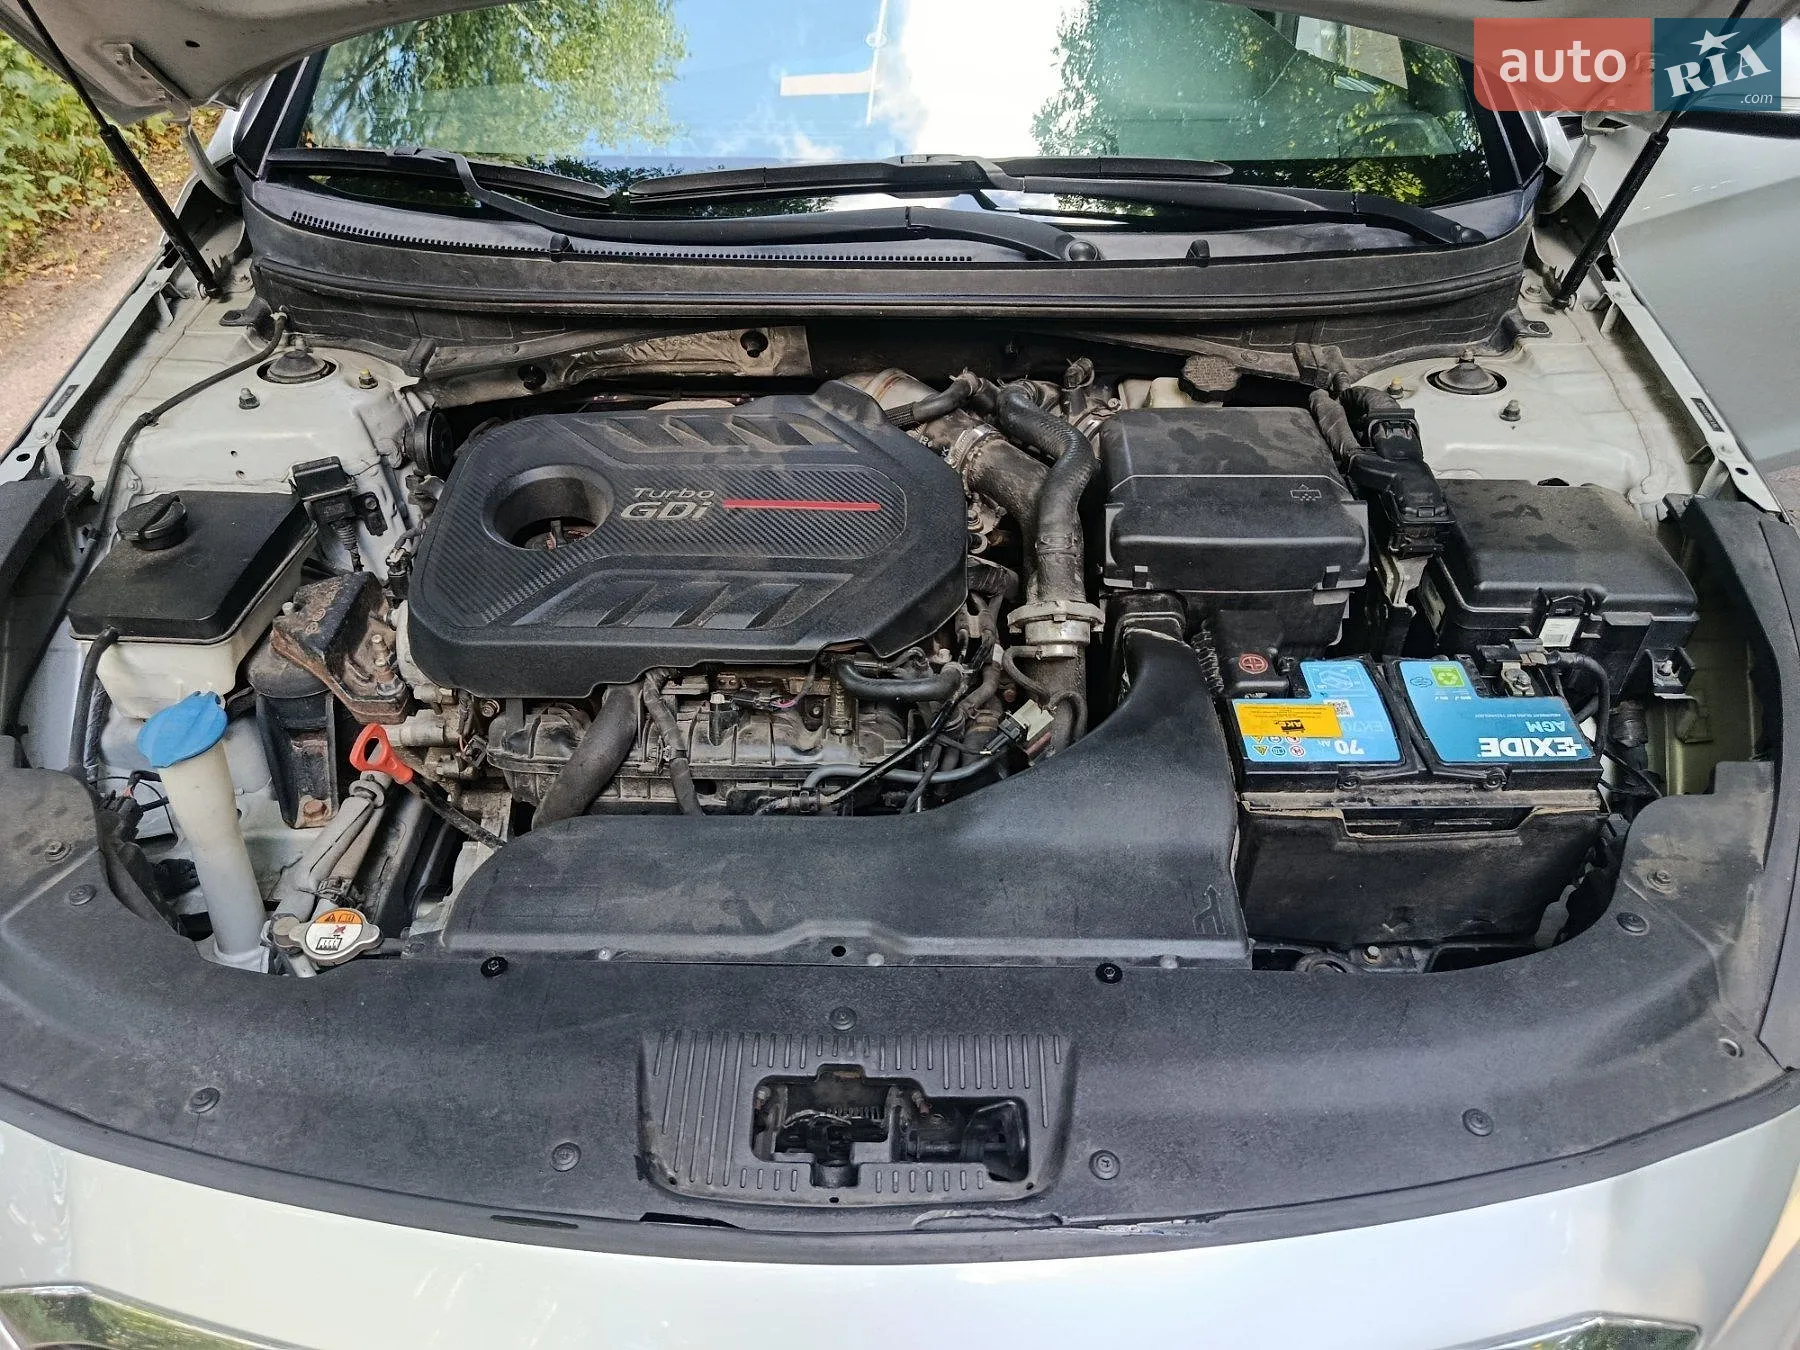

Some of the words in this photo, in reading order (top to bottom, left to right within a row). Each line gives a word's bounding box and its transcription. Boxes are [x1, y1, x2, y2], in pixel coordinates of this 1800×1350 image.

[633, 487, 715, 499] Turbo
[620, 501, 713, 519] GDi
[1526, 720, 1566, 733] AGM
[1334, 739, 1365, 755] 70
[1478, 736, 1583, 758] EXIDE
